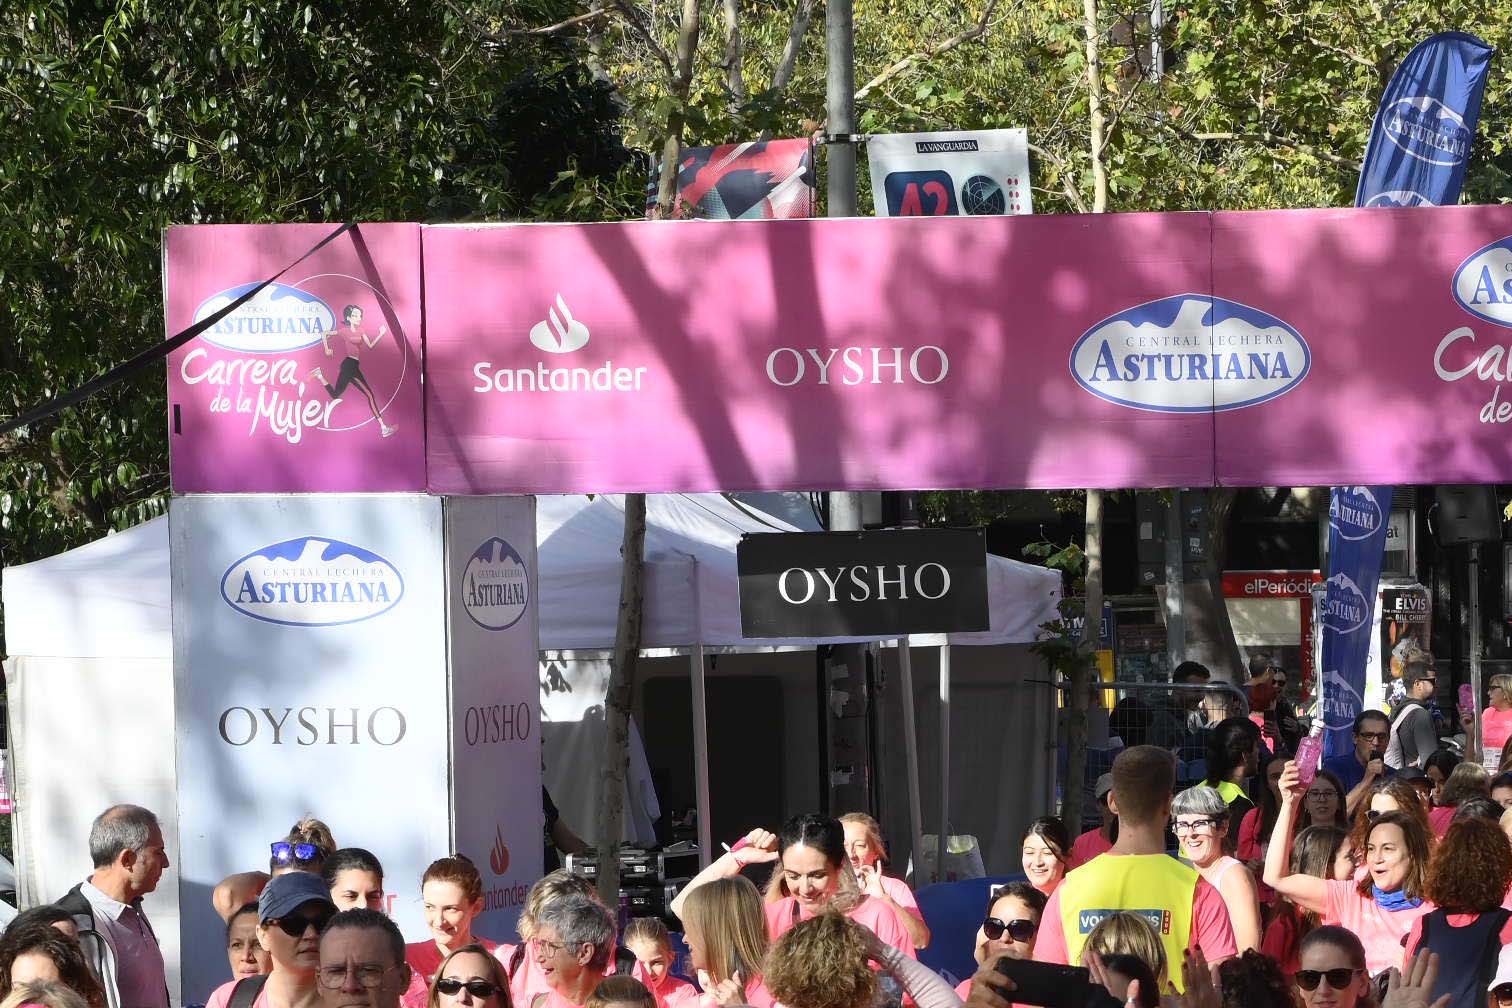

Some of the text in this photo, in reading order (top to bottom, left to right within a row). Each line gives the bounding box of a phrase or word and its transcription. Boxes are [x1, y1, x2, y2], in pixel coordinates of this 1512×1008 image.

[918, 141, 977, 152] LA VANGUARDIA
[1126, 334, 1283, 347] CENTRAL LECHERA
[181, 347, 298, 384] Carrera
[473, 361, 647, 393] Santander
[766, 345, 949, 386] OYSHO
[1089, 339, 1292, 382] ASTURIANA
[210, 380, 343, 444] de la Mujer
[1386, 526, 1399, 539] at
[235, 570, 392, 604] ASTURIANA
[263, 567, 385, 578] CENTRAL LECHERA
[779, 562, 951, 604] OYSHO
[1244, 580, 1315, 594] elPeriódi
[467, 574, 526, 607] ASTURIANA
[1395, 597, 1426, 610] ELVIS
[218, 706, 407, 747] OYSHO
[464, 702, 531, 747] OYSHO
[482, 880, 528, 911] antander
